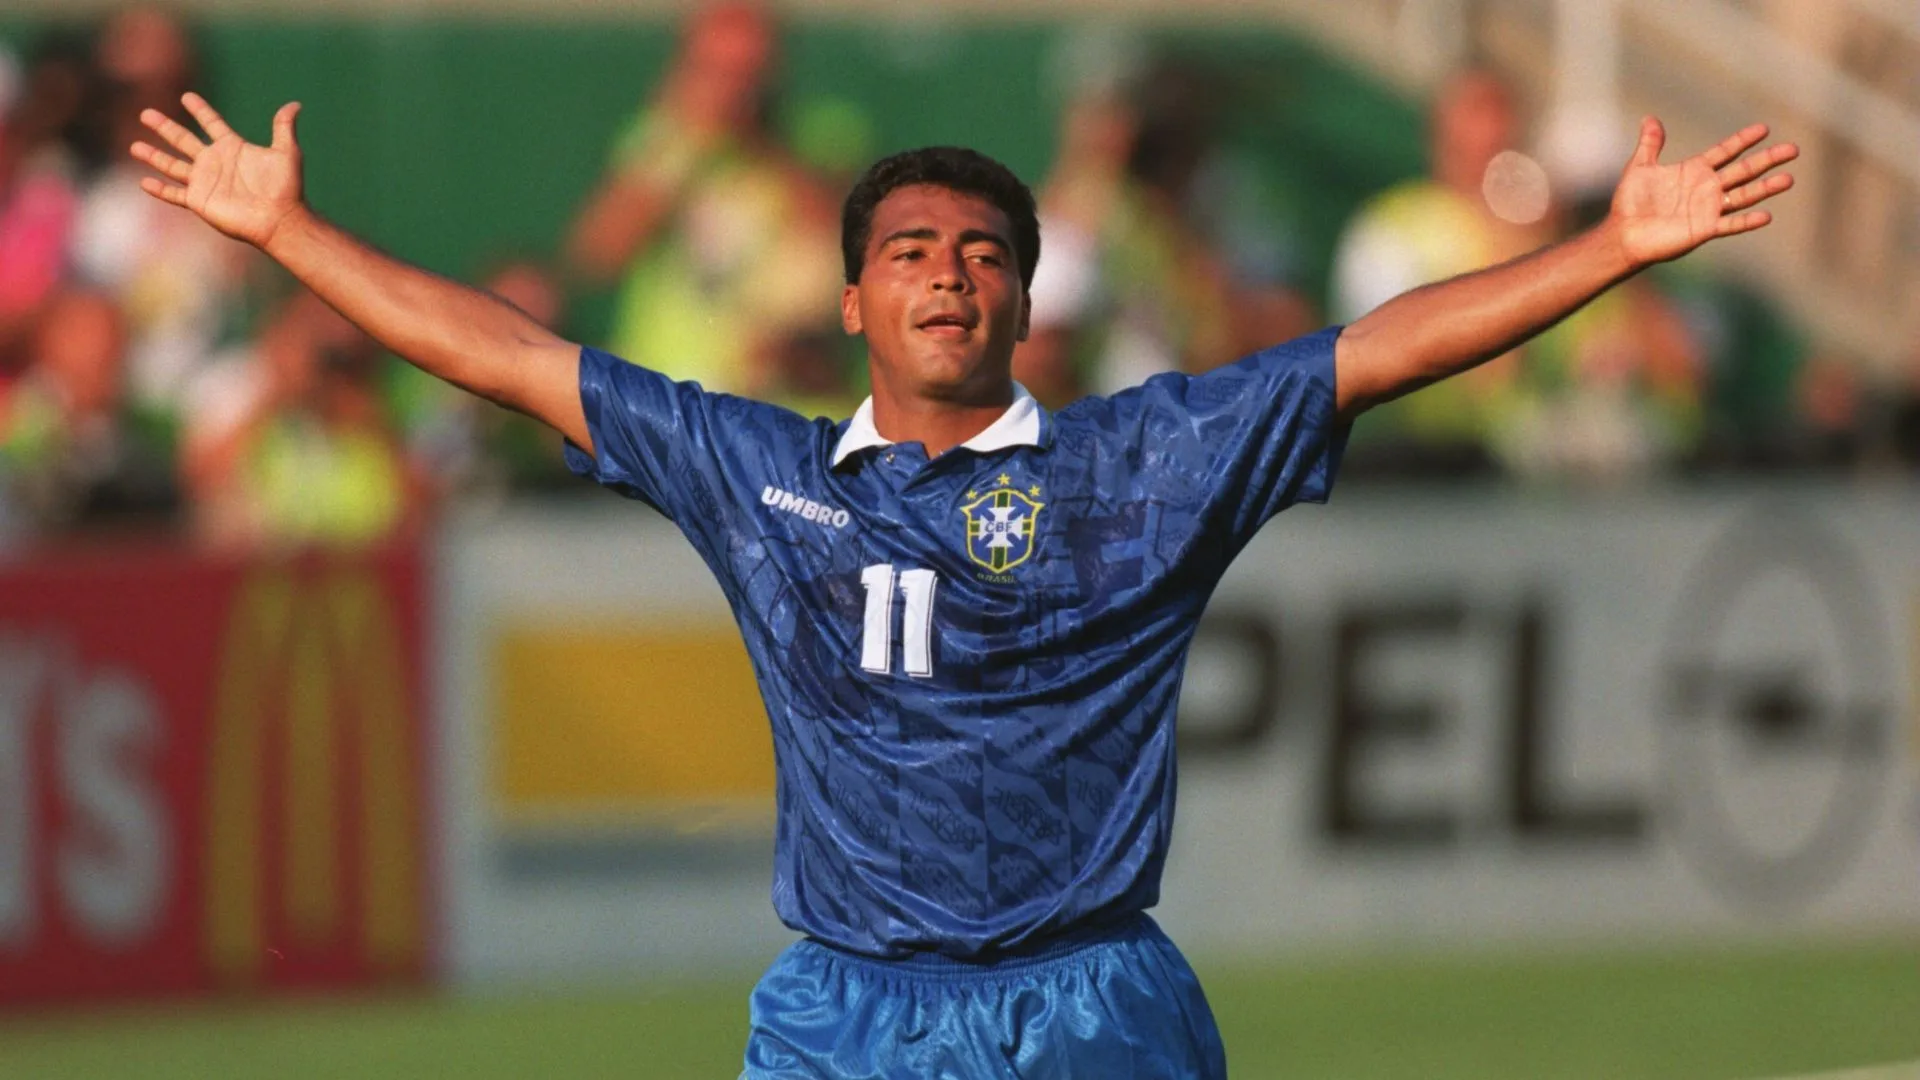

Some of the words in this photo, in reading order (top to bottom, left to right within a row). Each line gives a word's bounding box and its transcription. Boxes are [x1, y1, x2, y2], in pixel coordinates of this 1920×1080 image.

[761, 486, 850, 528] UMBRO
[984, 521, 1014, 533] CBF
[860, 563, 938, 678] 11
